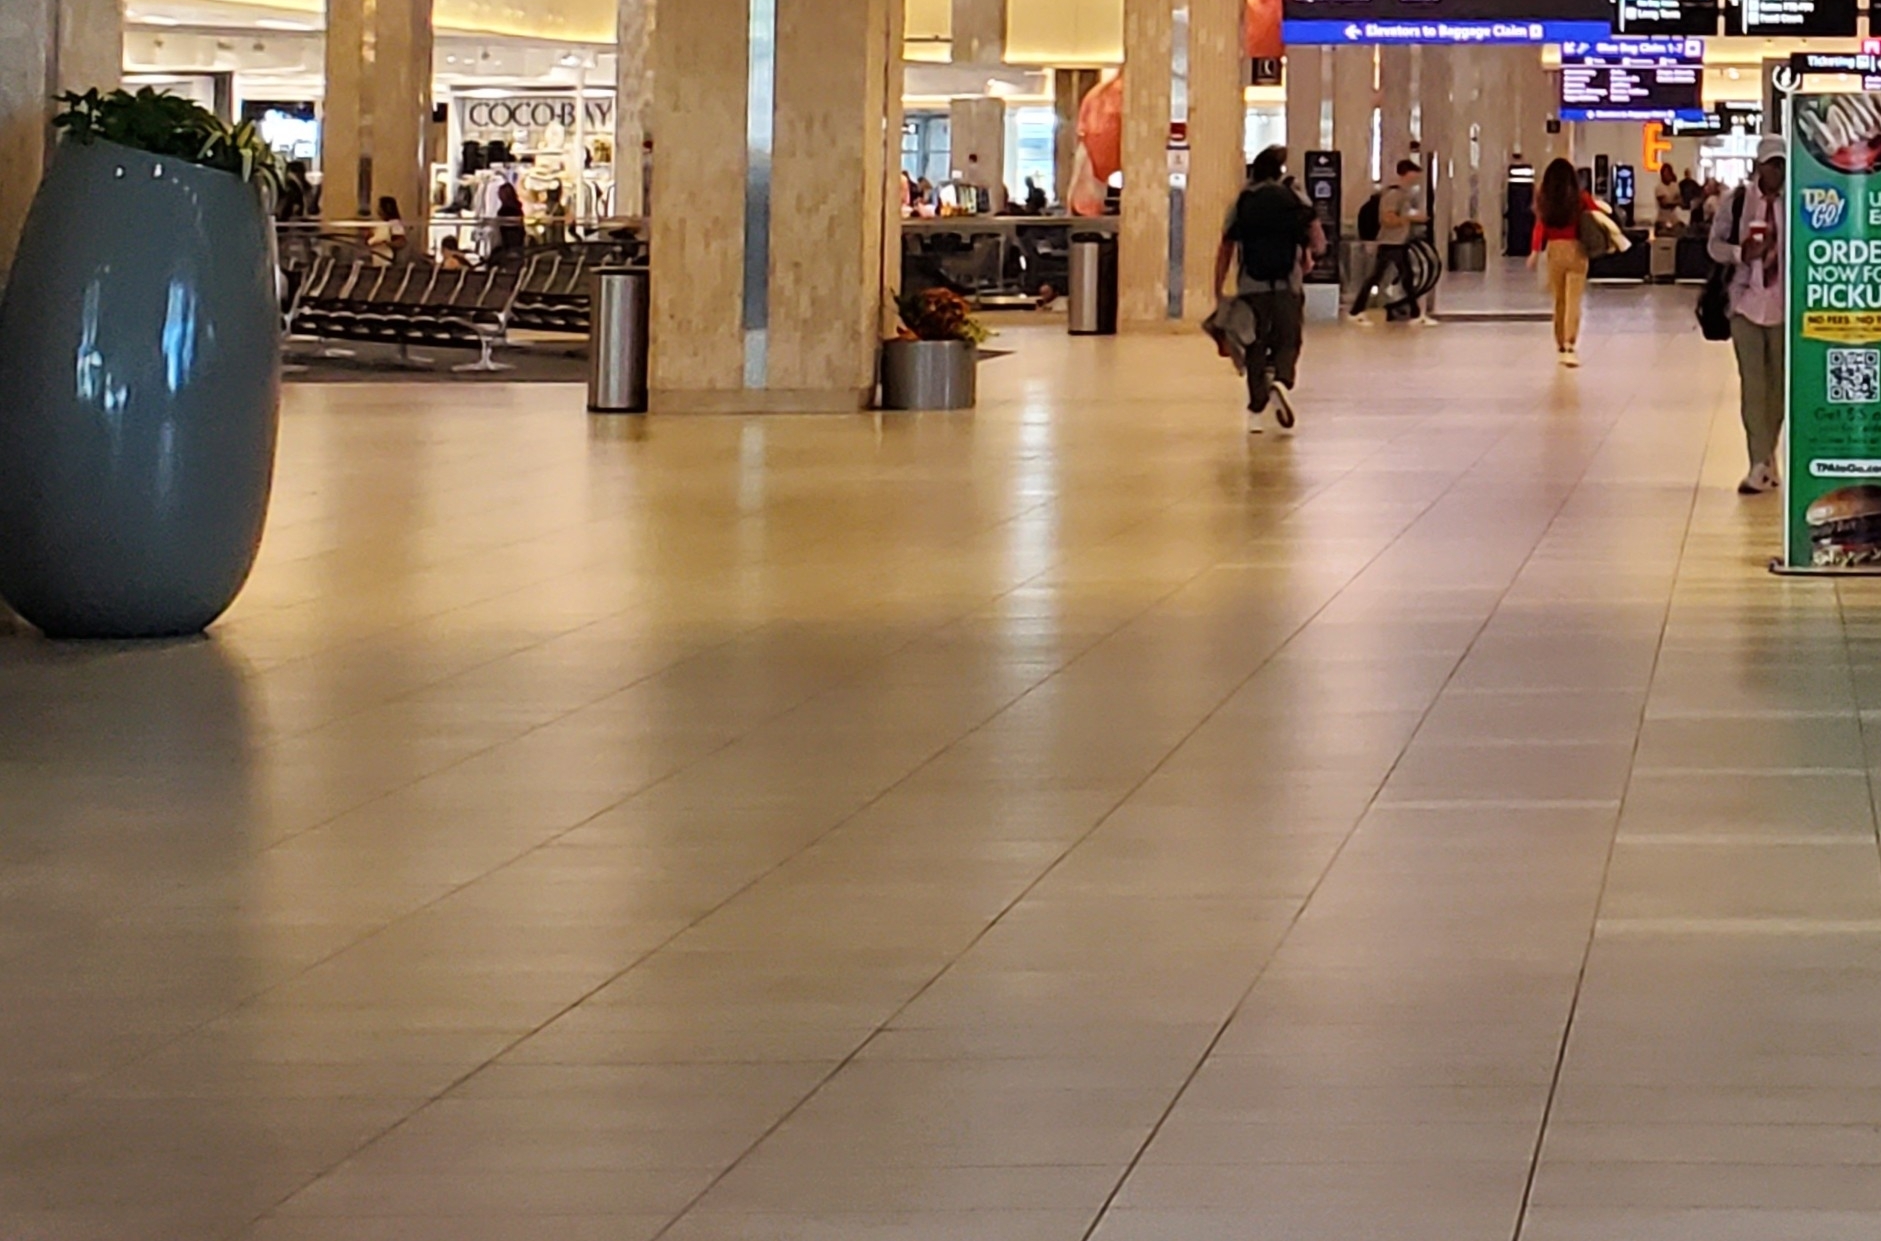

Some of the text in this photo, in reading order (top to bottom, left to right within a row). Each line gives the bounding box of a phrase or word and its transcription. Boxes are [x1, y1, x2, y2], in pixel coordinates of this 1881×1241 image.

[1366, 24, 1528, 41] Elevators to Baggage Claim
[1807, 55, 1855, 70] Ticketing
[1802, 188, 1839, 213] TPA
[1812, 198, 1847, 229] GO!
[1808, 266, 1859, 282] NOW
